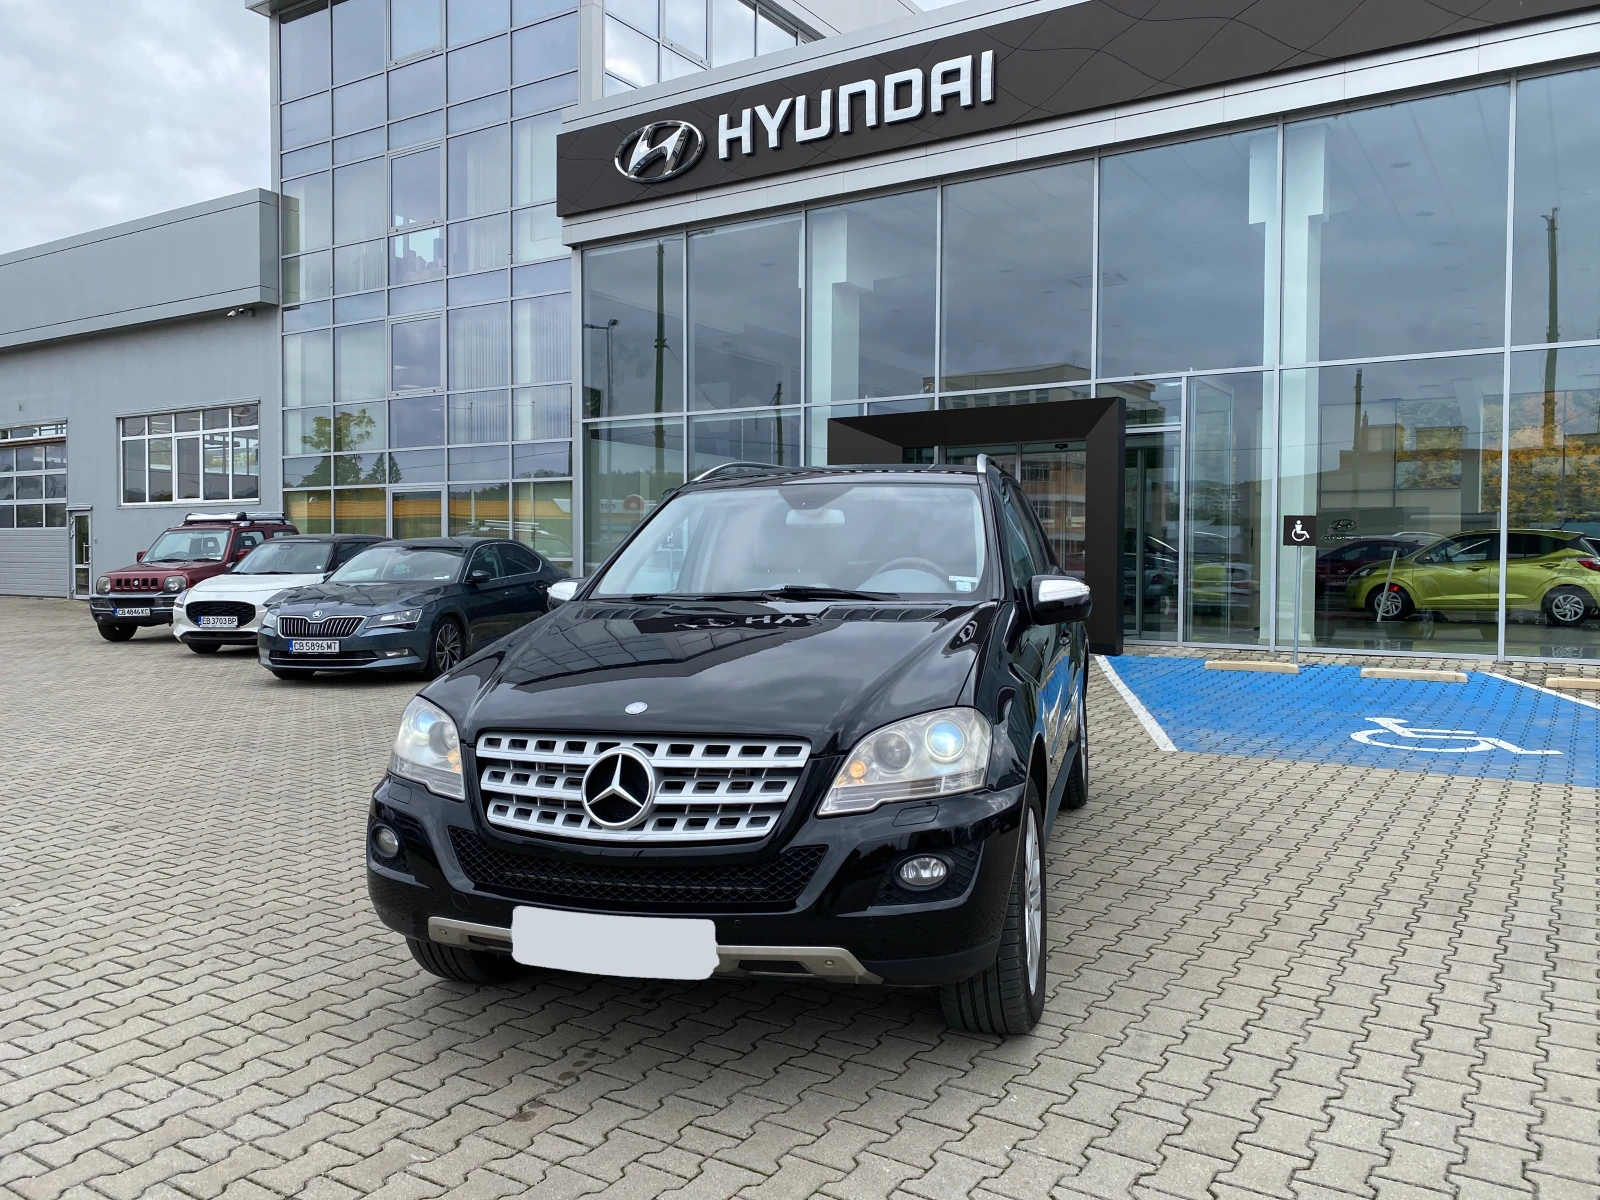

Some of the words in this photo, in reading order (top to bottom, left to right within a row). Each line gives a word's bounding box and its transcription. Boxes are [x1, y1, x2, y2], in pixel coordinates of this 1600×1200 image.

[718, 50, 995, 160] HYUNDAI
[202, 617, 211, 625] EB
[212, 617, 227, 625] 3703
[227, 617, 237, 625] BP
[293, 641, 304, 651] CB
[305, 641, 325, 651] 5896
[326, 641, 337, 651] MT
